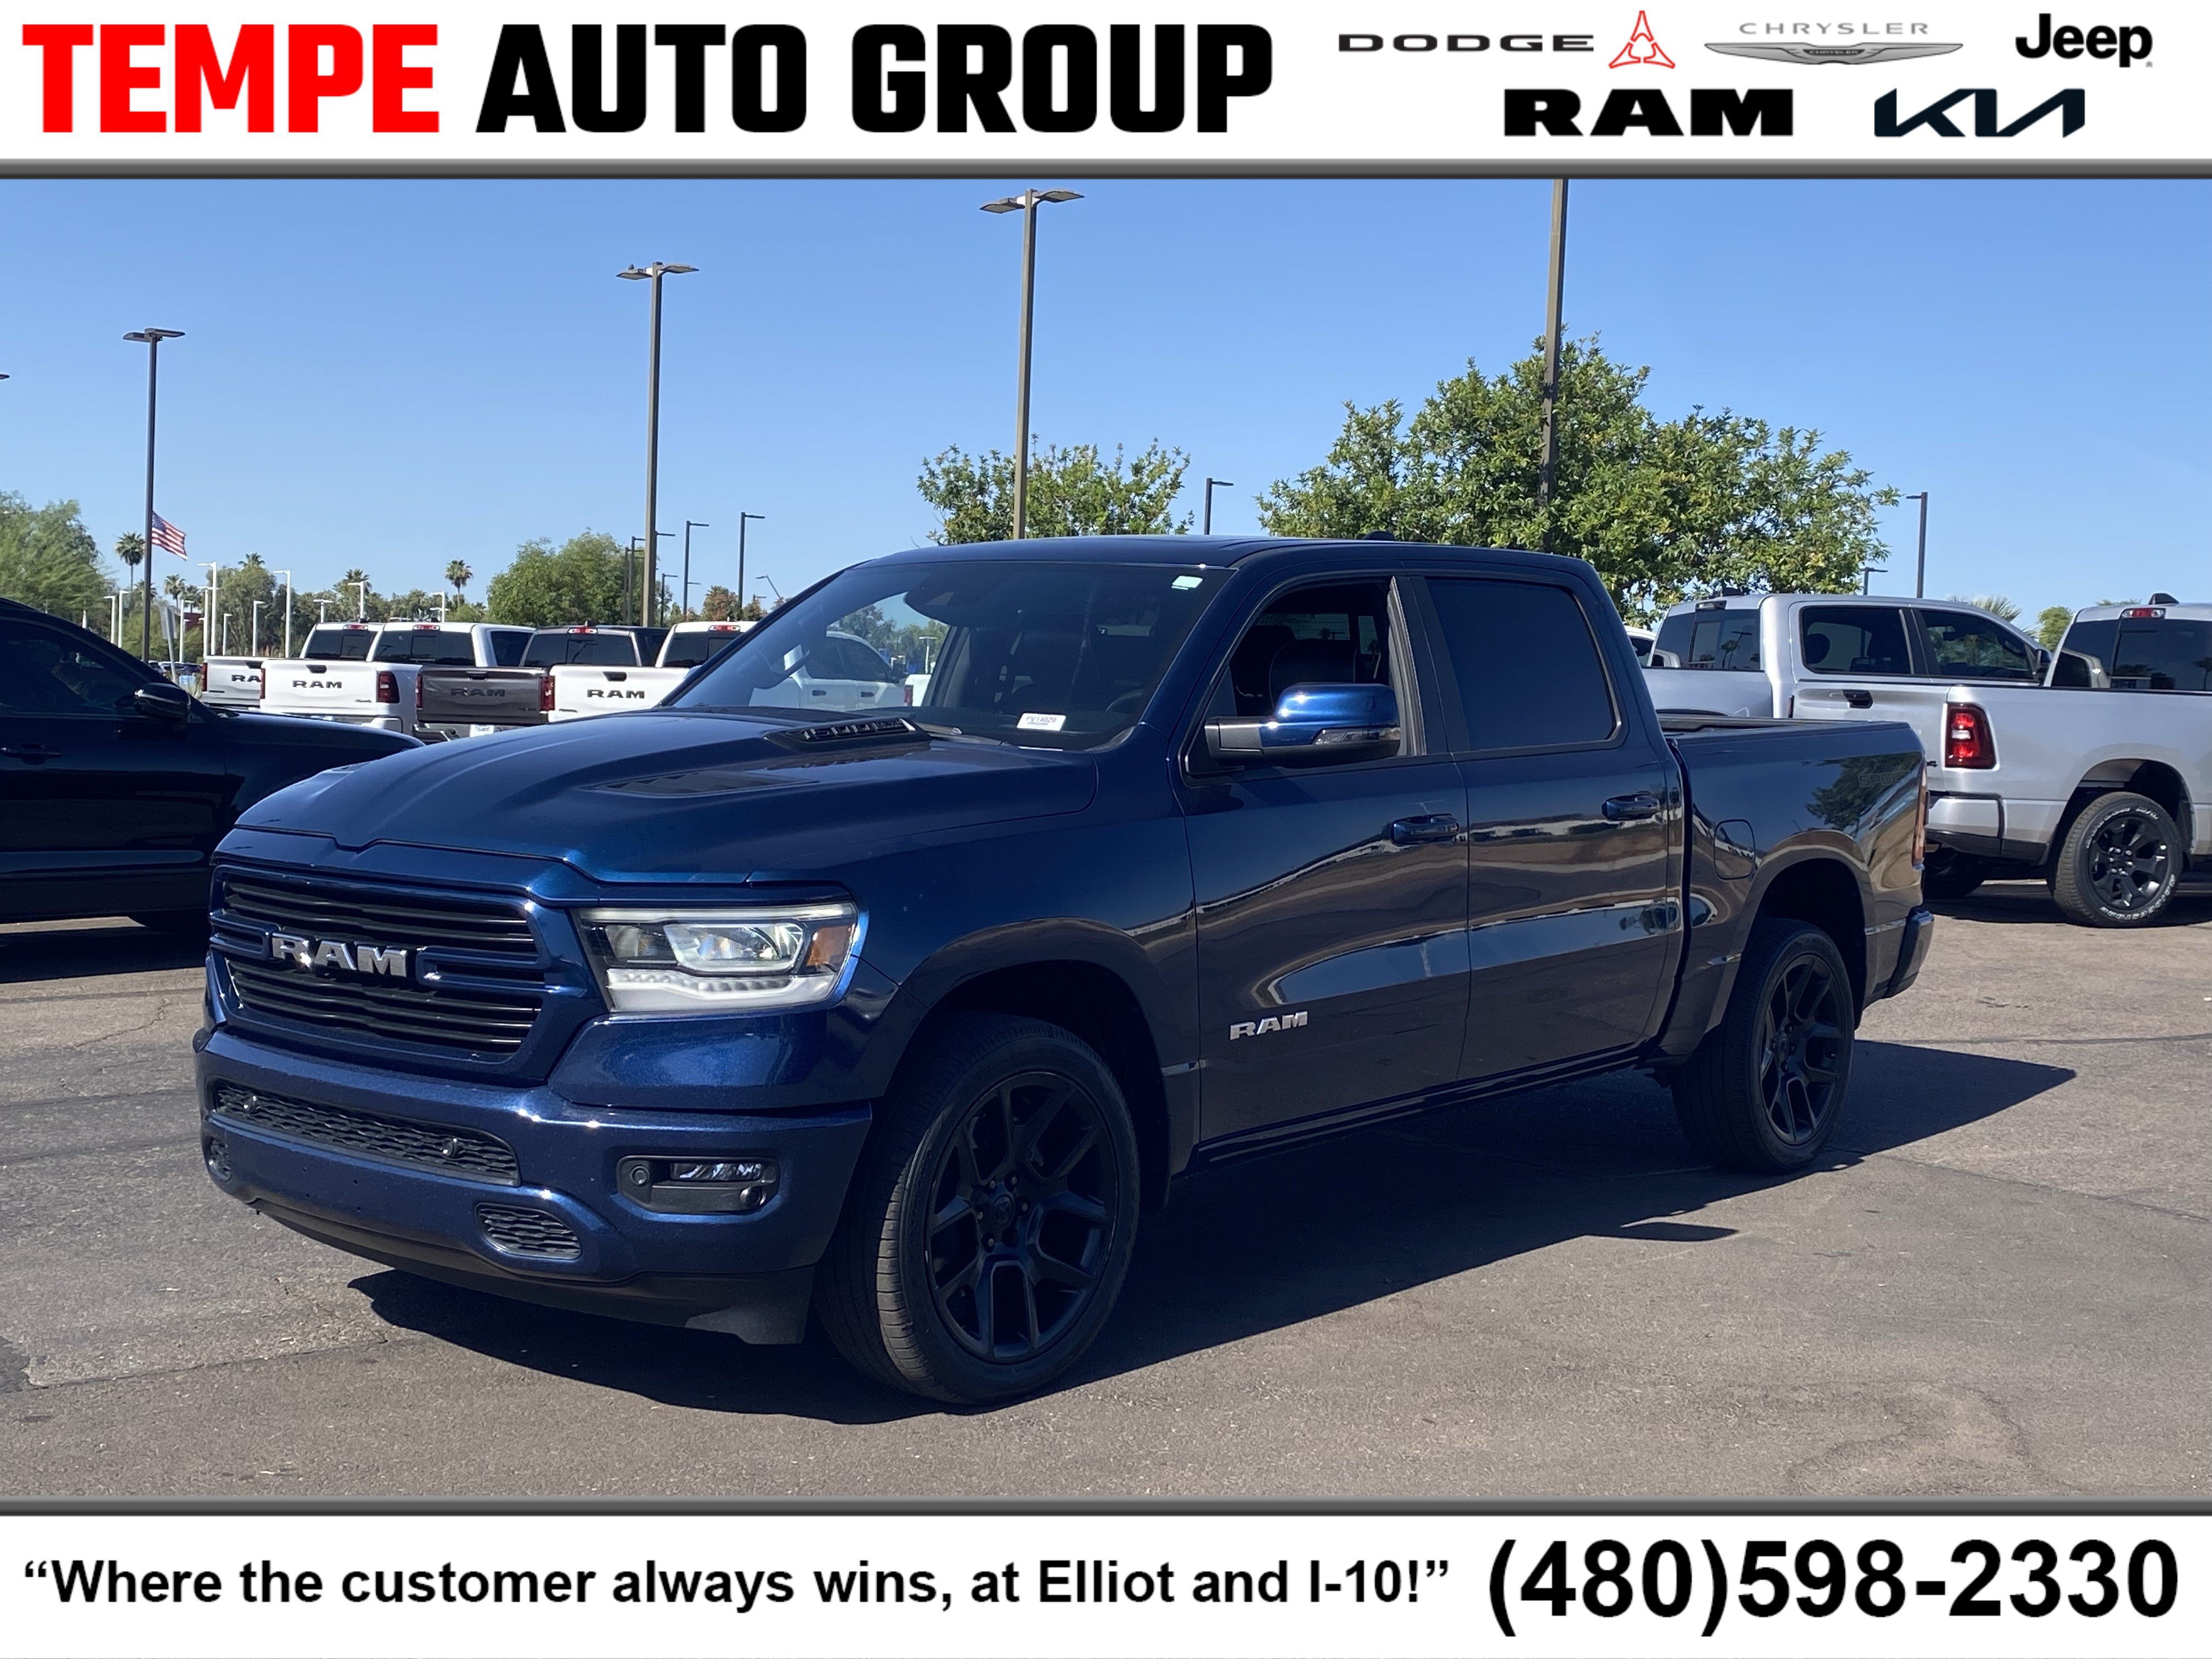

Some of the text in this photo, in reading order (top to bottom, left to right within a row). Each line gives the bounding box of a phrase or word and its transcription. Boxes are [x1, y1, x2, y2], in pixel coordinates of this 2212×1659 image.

[231, 674, 262, 682] RA
[292, 680, 342, 689] RAM
[450, 688, 505, 697] RAM
[587, 689, 645, 699] RAM
[272, 932, 407, 978] RAM
[1230, 1011, 1308, 1040] RAM
